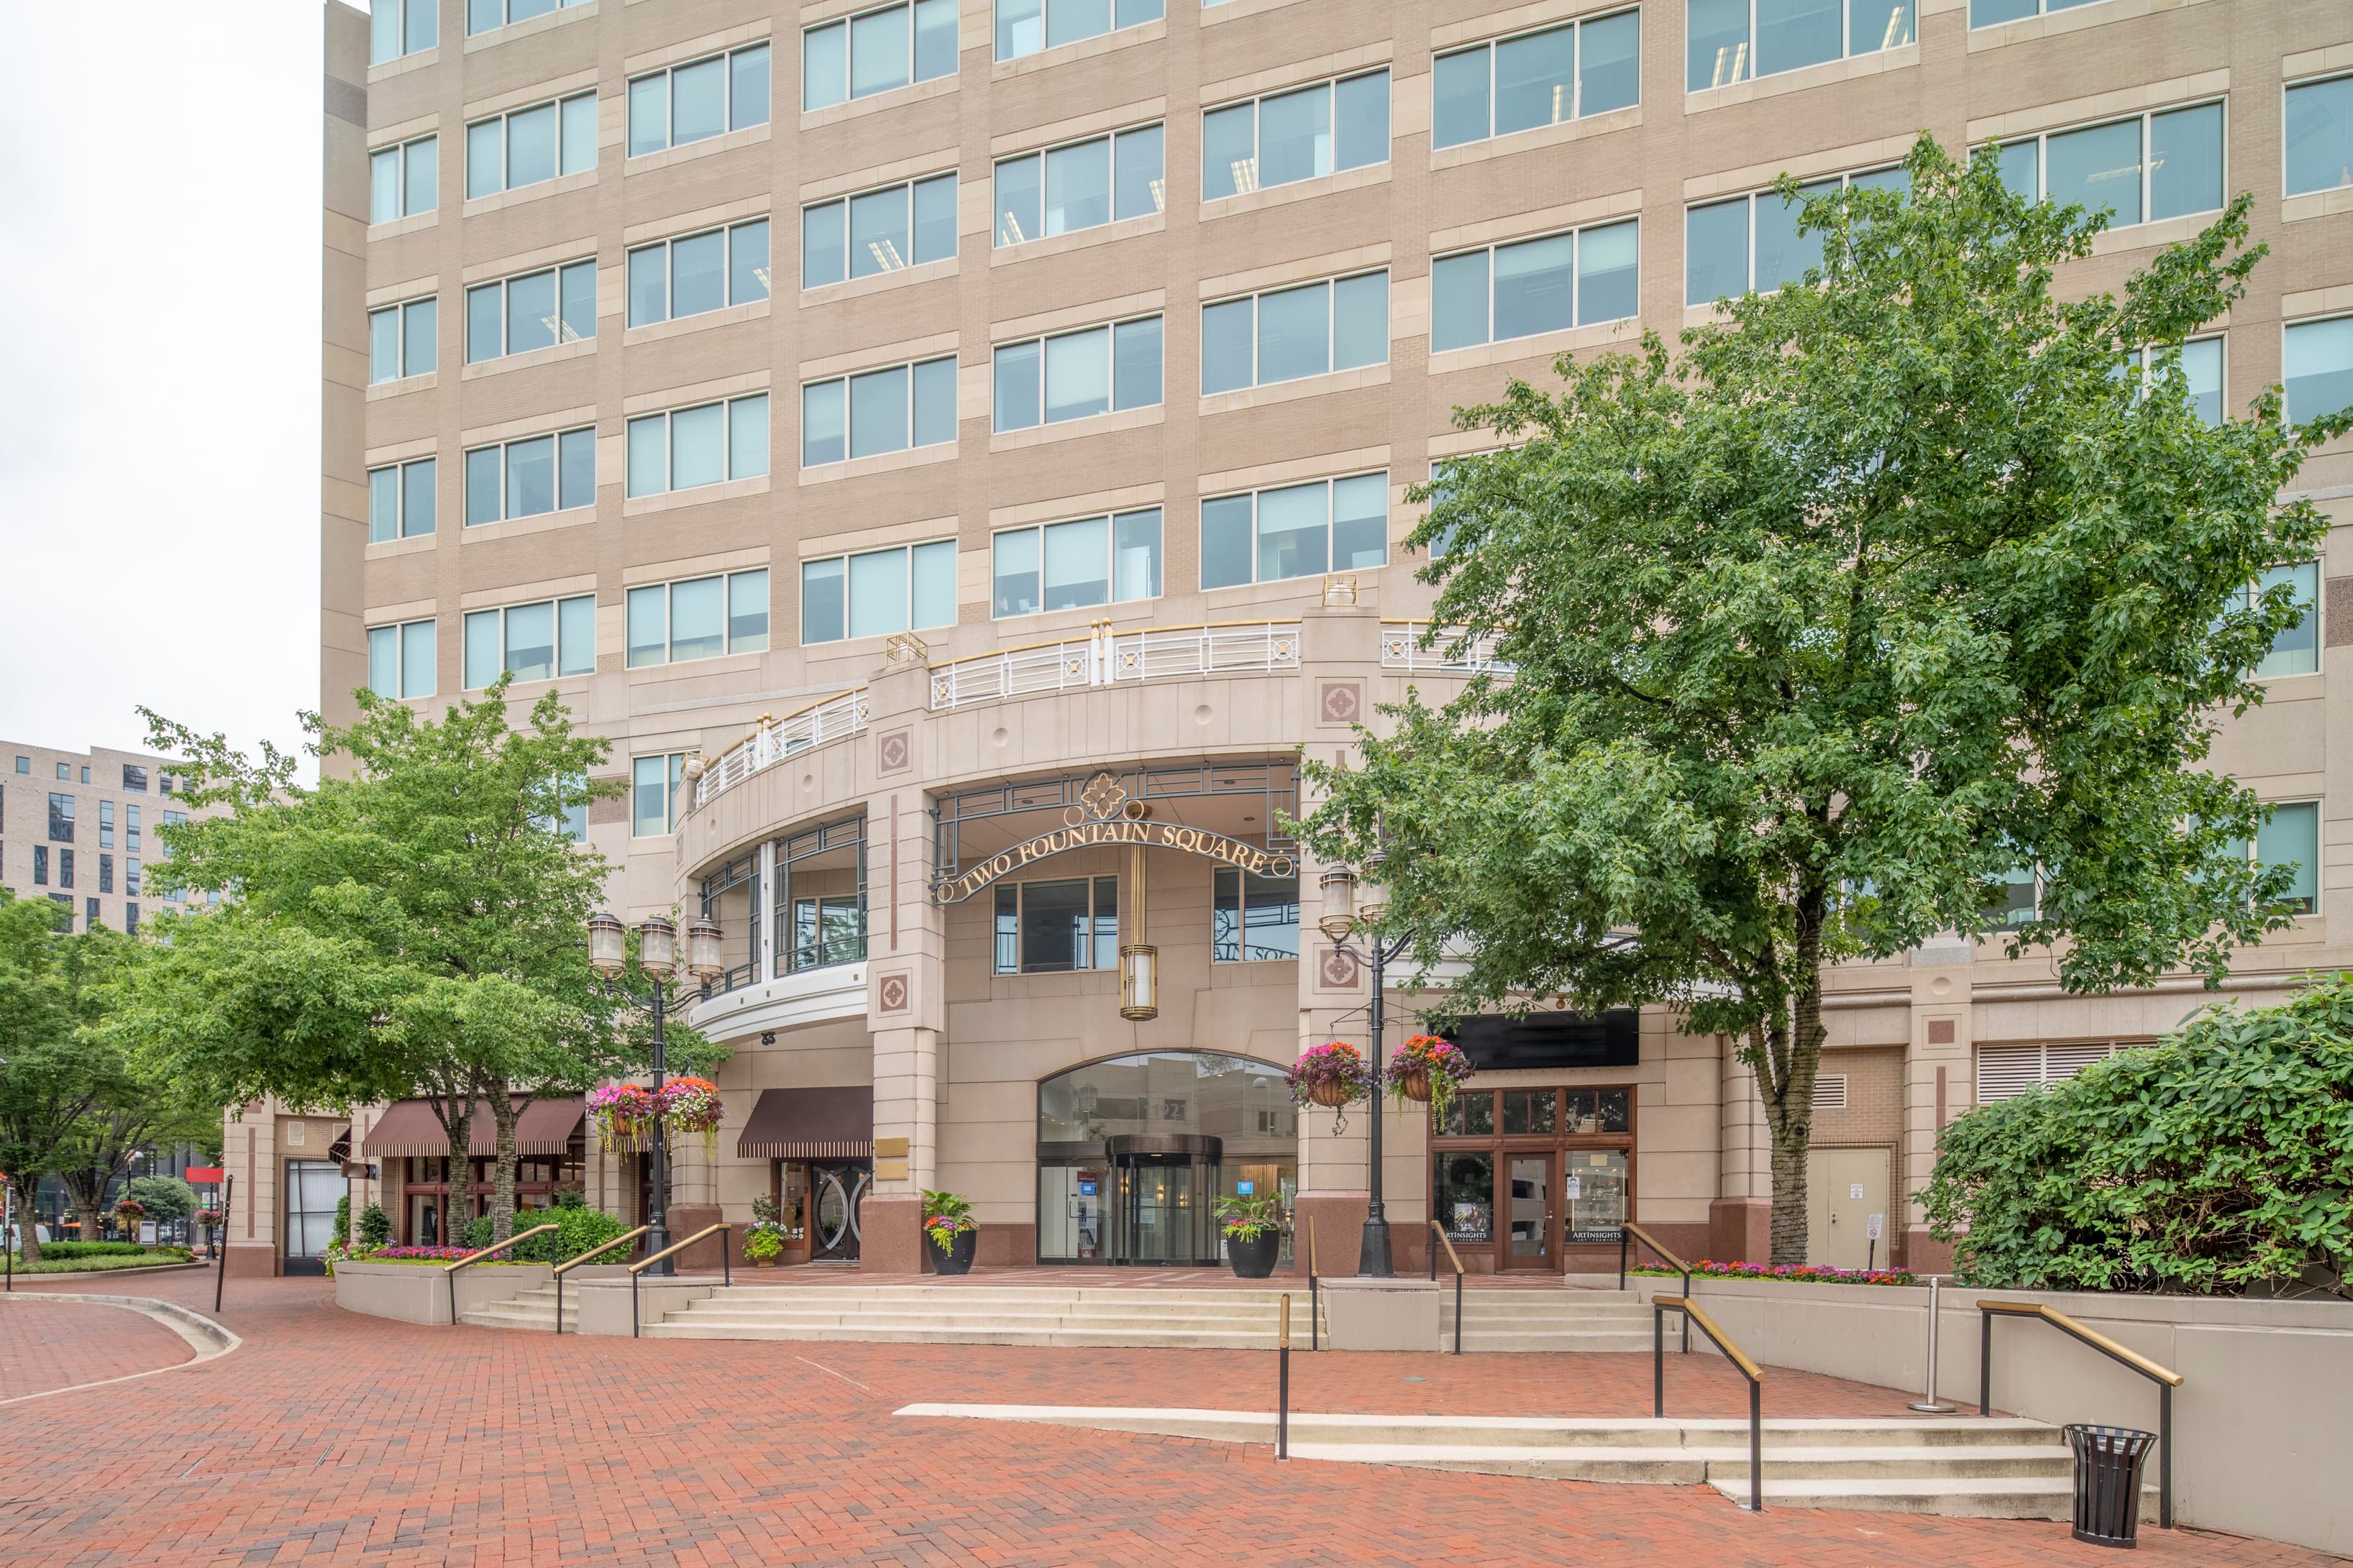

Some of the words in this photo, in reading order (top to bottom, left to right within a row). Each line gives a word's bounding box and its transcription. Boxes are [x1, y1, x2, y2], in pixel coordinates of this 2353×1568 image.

[959, 855, 1011, 896] TWO
[1018, 822, 1152, 864] FOUNTAIN
[1161, 826, 1268, 874] SQUARE
[1143, 1103, 1187, 1117] 11921
